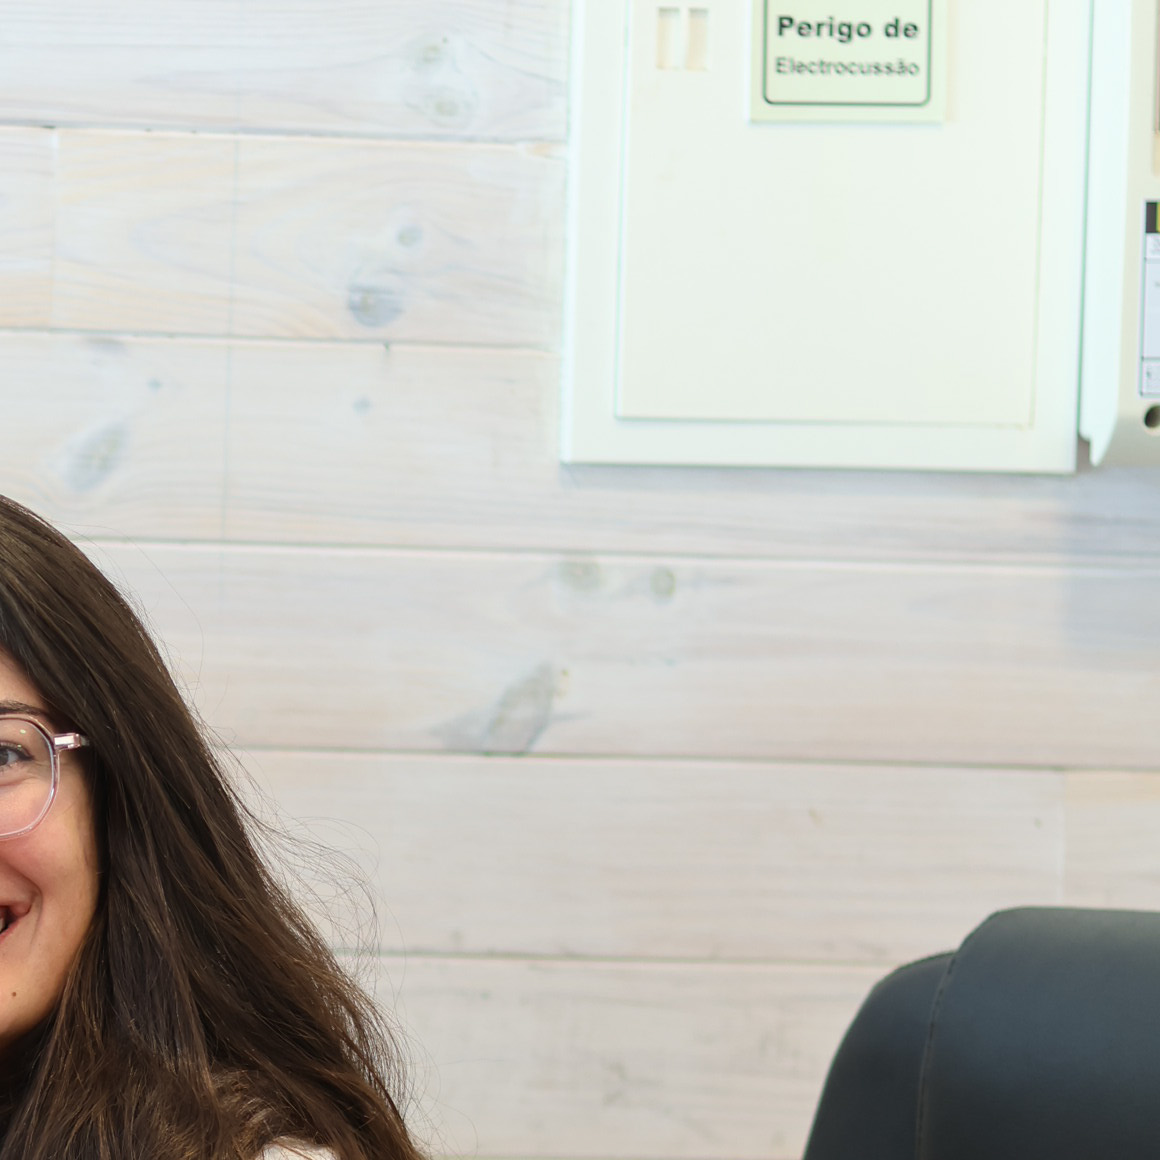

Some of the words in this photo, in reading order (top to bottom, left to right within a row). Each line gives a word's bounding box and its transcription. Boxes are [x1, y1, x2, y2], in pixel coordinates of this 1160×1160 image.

[777, 16, 872, 43] Perigo
[884, 17, 919, 38] de
[776, 56, 920, 75] Electrocussão
